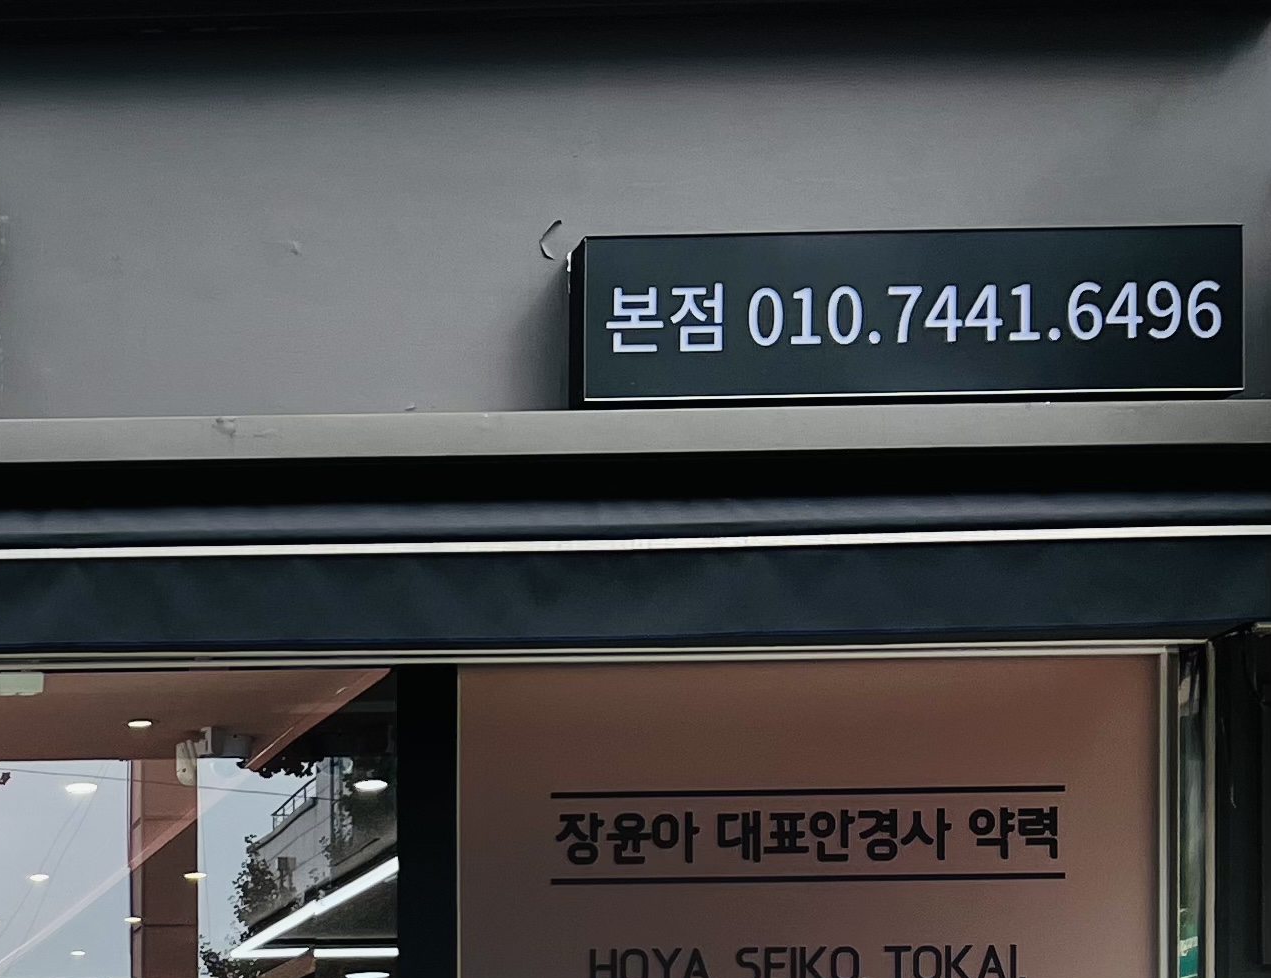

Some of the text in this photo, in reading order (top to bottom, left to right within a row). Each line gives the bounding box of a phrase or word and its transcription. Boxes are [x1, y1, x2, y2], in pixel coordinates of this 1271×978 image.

[605, 280, 1224, 353] 본점 010.7441.6496
[554, 805, 1060, 865] 장윤아 대표안경사 약력
